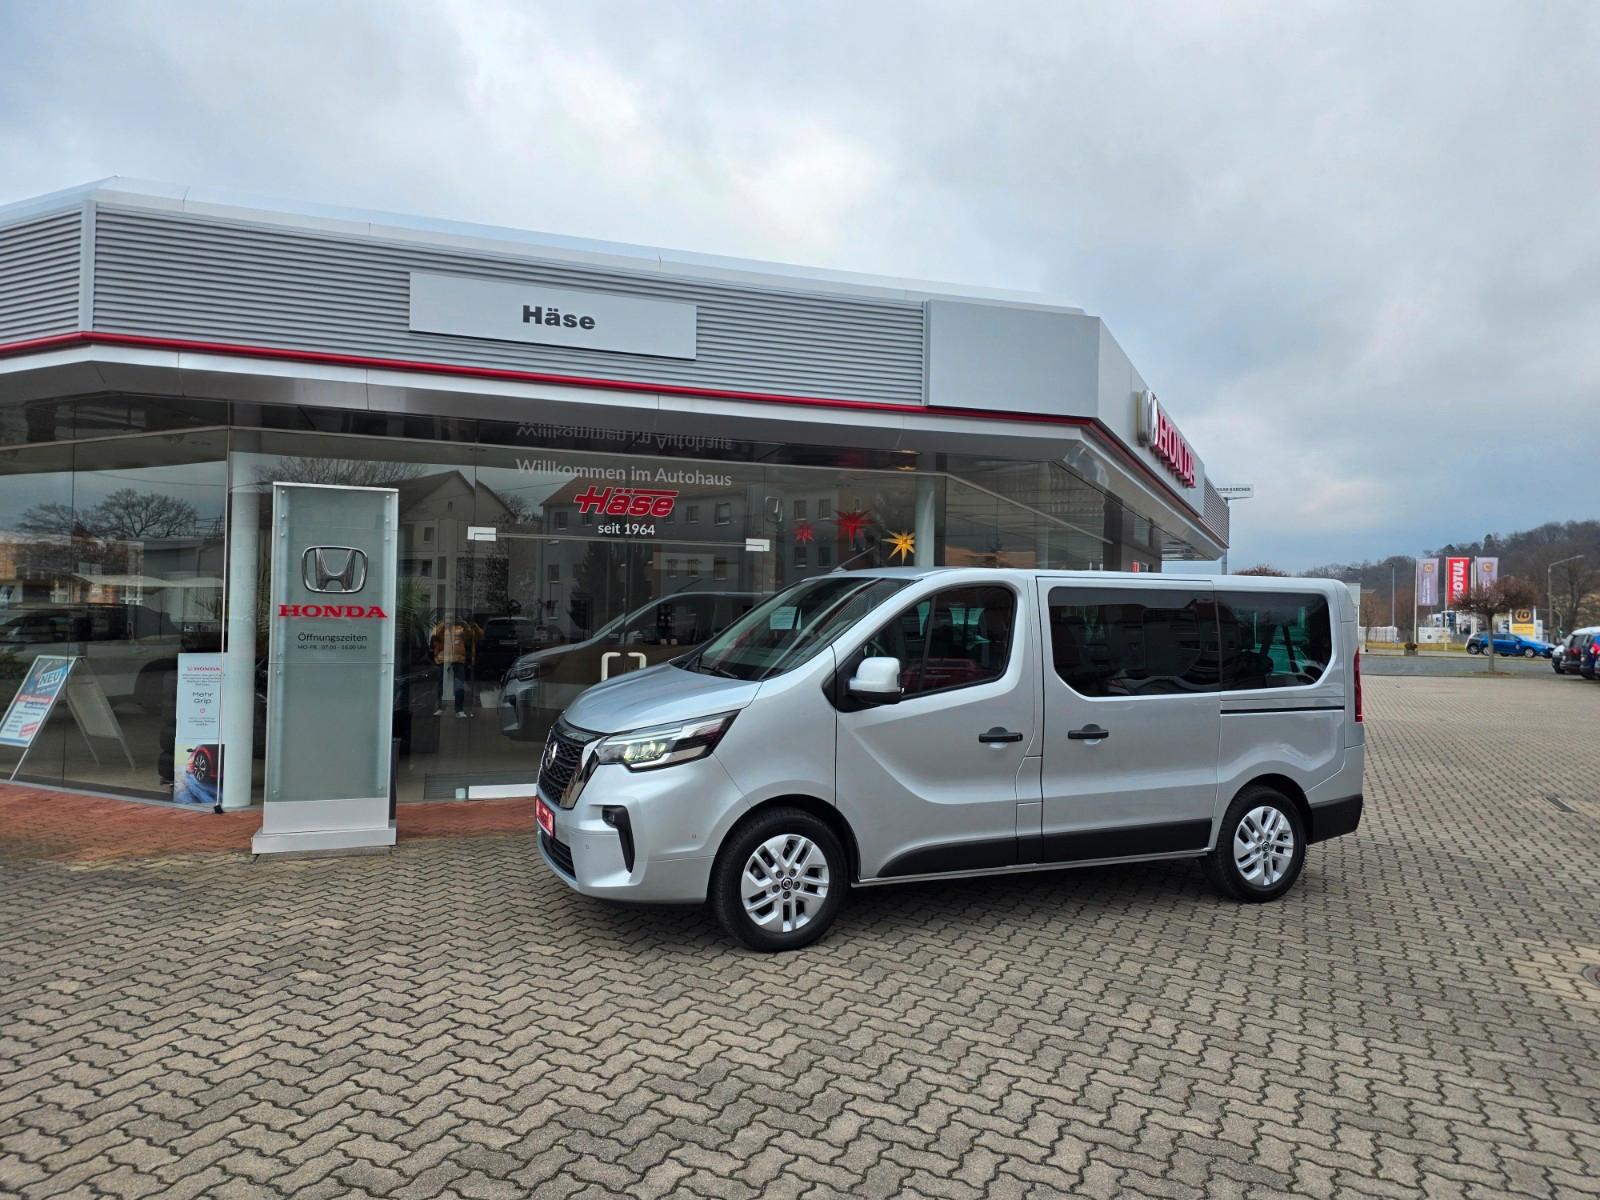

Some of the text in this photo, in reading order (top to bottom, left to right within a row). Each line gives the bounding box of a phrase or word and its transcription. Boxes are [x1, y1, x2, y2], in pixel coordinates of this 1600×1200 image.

[522, 304, 596, 330] Häse
[1155, 413, 1196, 488] HONDA
[515, 458, 733, 486] Willkommen im Autohaus
[573, 485, 680, 518] Häse
[597, 523, 656, 535] seit 1964
[278, 604, 388, 619] HONDA
[297, 631, 368, 643] Öffnungszeiten
[40, 671, 61, 684] NEU
